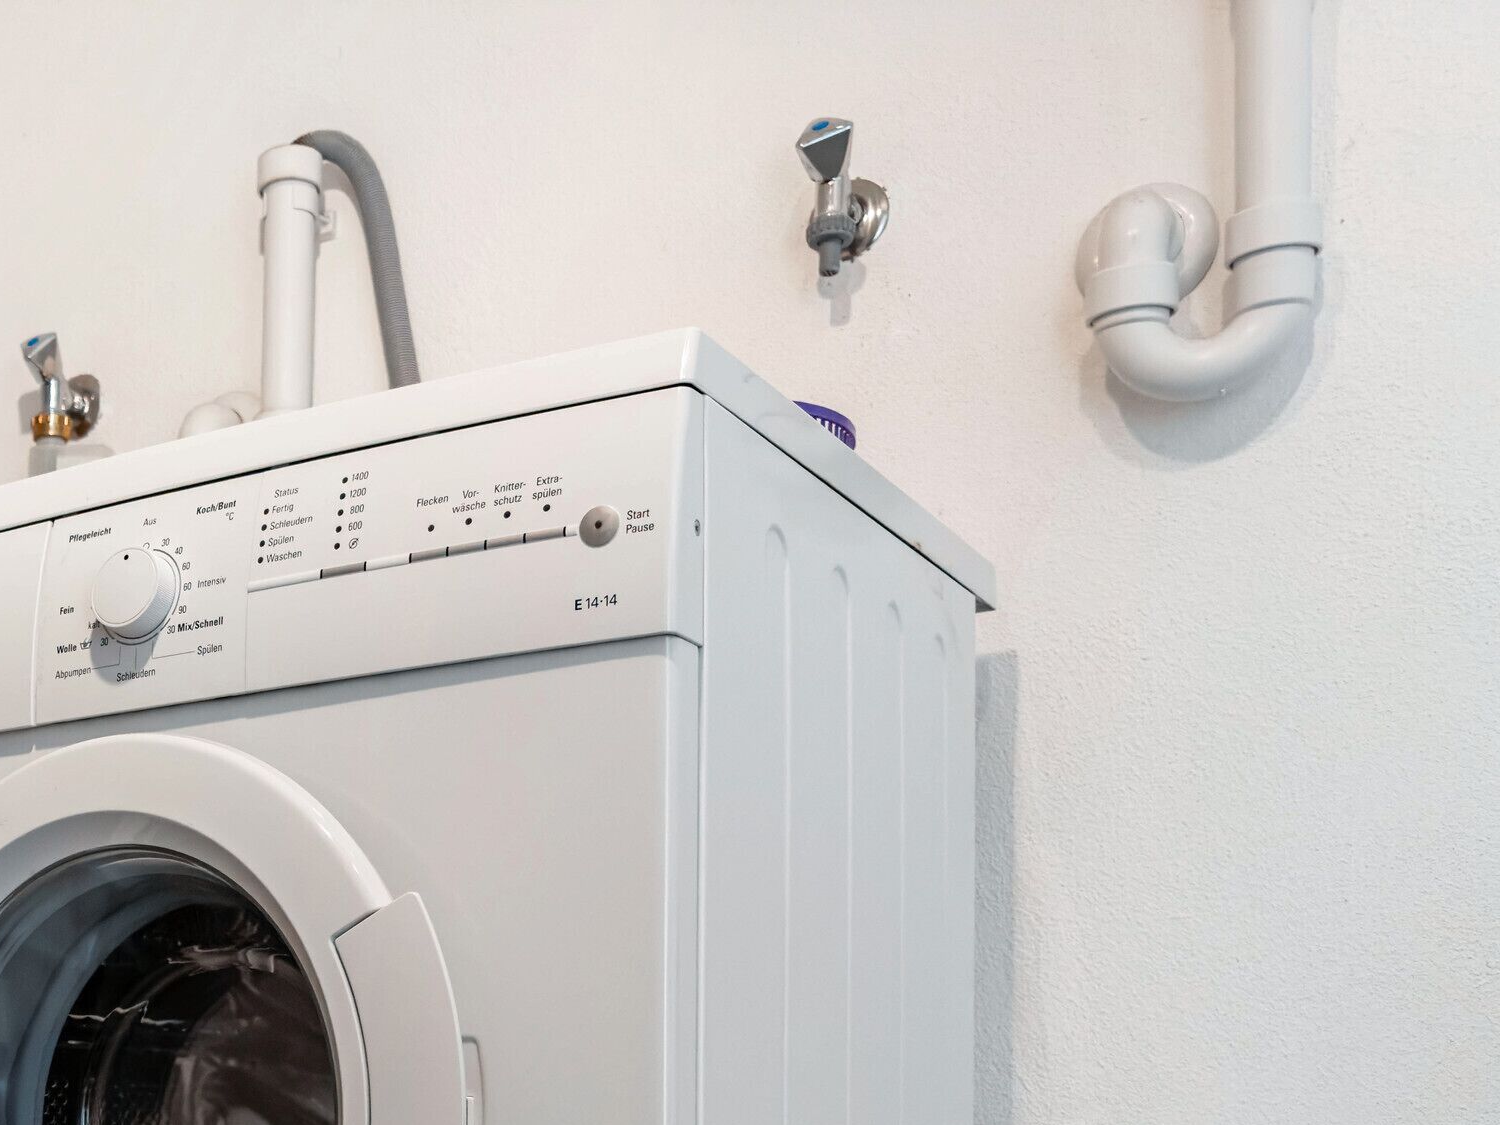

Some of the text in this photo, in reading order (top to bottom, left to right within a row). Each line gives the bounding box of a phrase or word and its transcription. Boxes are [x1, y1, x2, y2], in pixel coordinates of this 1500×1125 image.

[352, 471, 369, 481] 1400
[536, 475, 563, 486] Extra-
[274, 487, 299, 499] Status
[349, 487, 367, 498] 1200
[494, 480, 527, 494] Knitter-
[462, 489, 480, 500] Vor-
[532, 487, 563, 501] spülen
[416, 495, 449, 508] Flecken
[493, 494, 523, 507] schutz
[196, 500, 237, 516] Koch/Bunt
[272, 503, 294, 514] Fertig
[349, 504, 365, 515] 800
[452, 500, 486, 514] wäsche
[626, 509, 650, 521] Start
[143, 518, 157, 527] Aus
[270, 515, 313, 531] Schleudern
[348, 520, 363, 531] 600
[625, 522, 655, 534] Pause
[68, 527, 112, 543] Pflegeleicht
[268, 534, 295, 548] Spülen
[161, 538, 171, 547] 30
[175, 546, 183, 555] 40
[266, 550, 302, 563] Waschen
[182, 562, 191, 571] 60
[183, 577, 227, 591] 60 Intensiv
[59, 606, 75, 615] Fein
[178, 605, 187, 614] 90
[574, 599, 583, 611] E
[167, 617, 224, 634] 30 Mix/Schnell
[56, 638, 109, 654] Wolle 30
[197, 643, 223, 656] Spülen
[55, 666, 92, 680] Abpumpen
[116, 669, 156, 682] Schleudern
